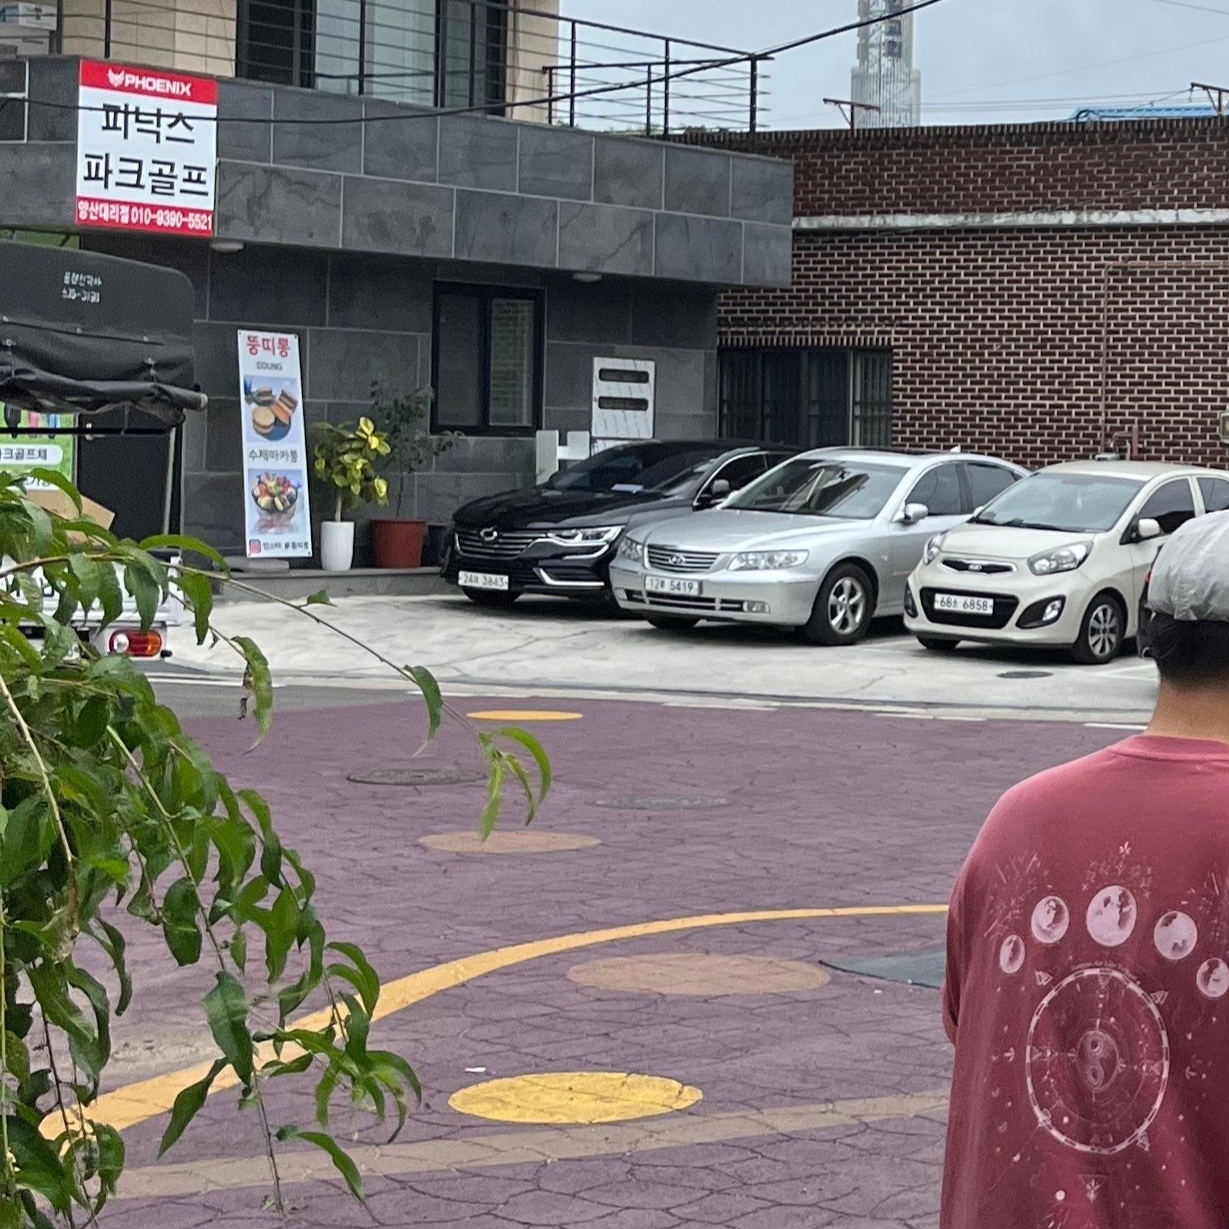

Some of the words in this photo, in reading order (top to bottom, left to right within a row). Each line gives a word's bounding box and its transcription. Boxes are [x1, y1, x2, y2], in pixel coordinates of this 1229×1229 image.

[125, 73, 192, 97] PHOENIX
[102, 103, 195, 144] 피닉스
[83, 153, 209, 197] 파크골프
[78, 200, 130, 225] 양산대리점
[0, 448, 47, 461] 크골프채
[669, 581, 694, 592] 5419
[963, 598, 989, 612] 6858
